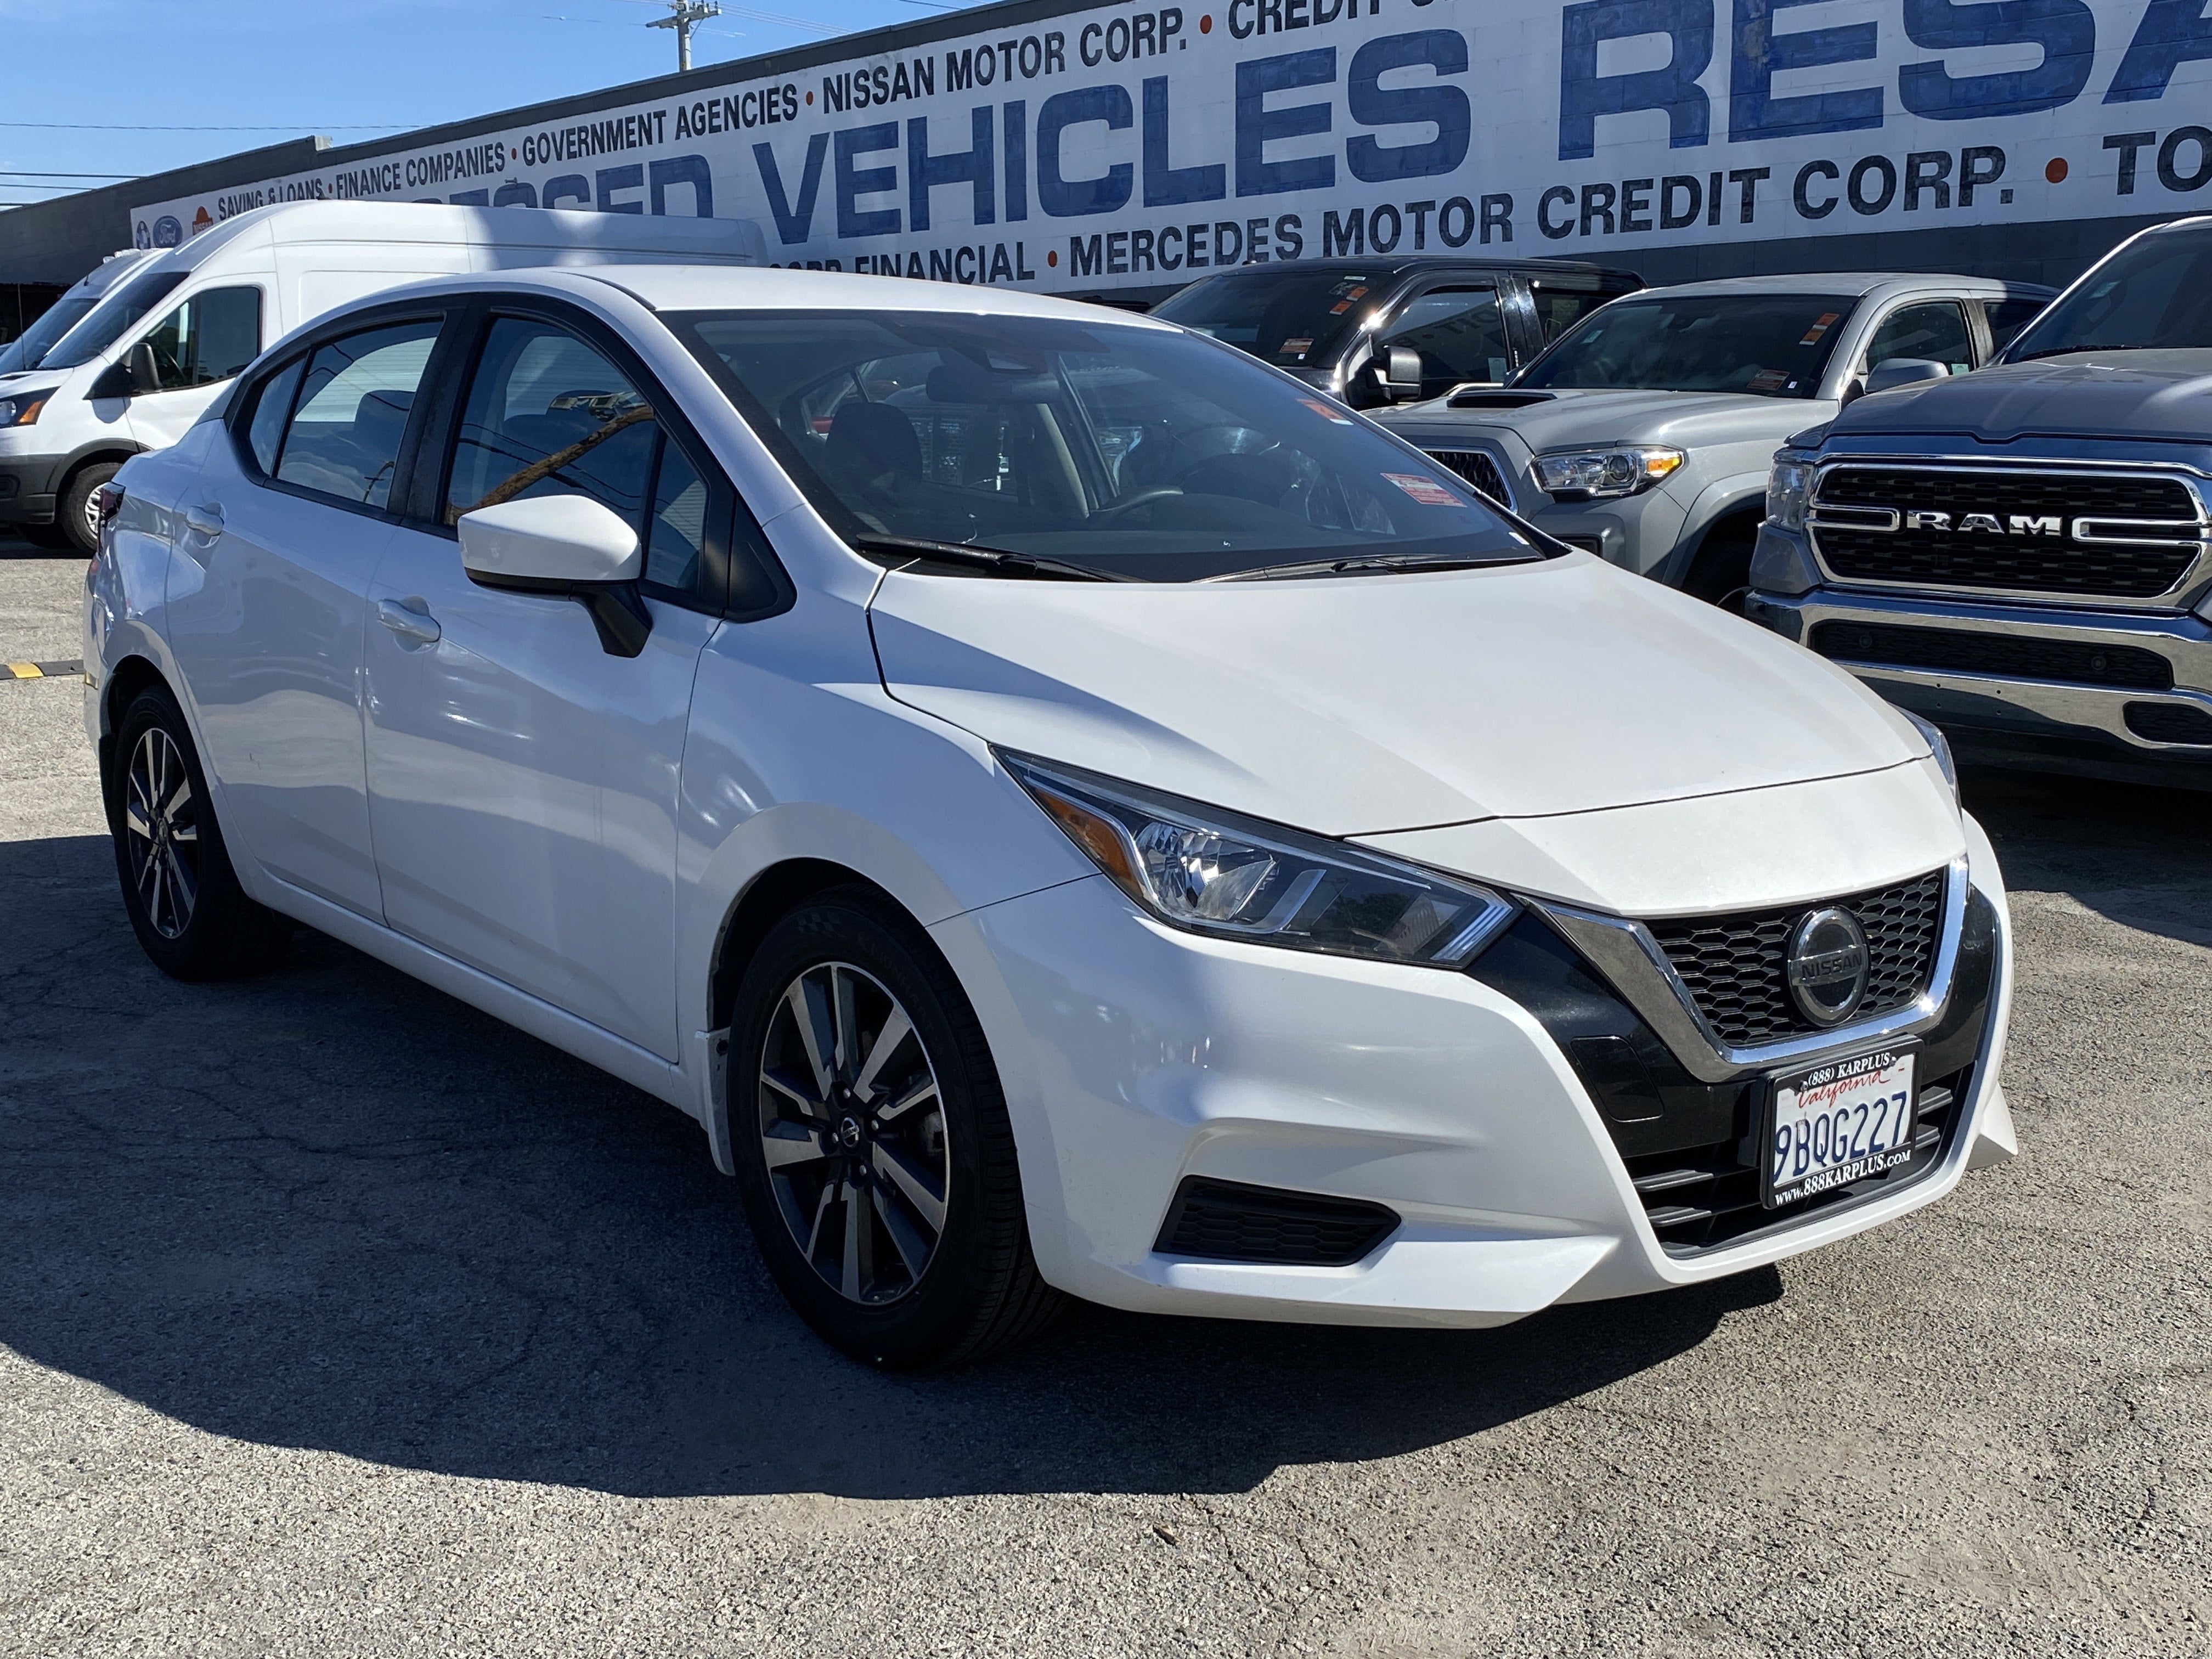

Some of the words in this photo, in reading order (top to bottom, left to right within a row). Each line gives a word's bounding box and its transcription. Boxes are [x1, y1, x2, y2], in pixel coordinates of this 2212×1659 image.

[218, 189, 263, 221] SAVING
[336, 162, 401, 199] FINANCE
[405, 141, 505, 188] COMPANIES
[522, 109, 666, 166] GOVERNMENT
[674, 83, 799, 140] AGENCIES
[822, 56, 935, 115] NISSAN
[946, 31, 1065, 92] MOTOR
[1080, 7, 1187, 67] CORP.
[752, 29, 1471, 245] VEHICLES
[1069, 213, 1304, 277] MERCEDES
[1323, 193, 1514, 257] MOTOR
[1536, 167, 1770, 240] CREDIT
[1792, 144, 2014, 219] CORP.
[1907, 510, 2063, 537] RAM
[1802, 952, 1862, 979] NISSAN
[1798, 1069, 1892, 1109] California
[1808, 1067, 1835, 1087] (888)
[1837, 1052, 1891, 1079] KARPLUS
[1774, 1090, 1907, 1183] 9BQG227
